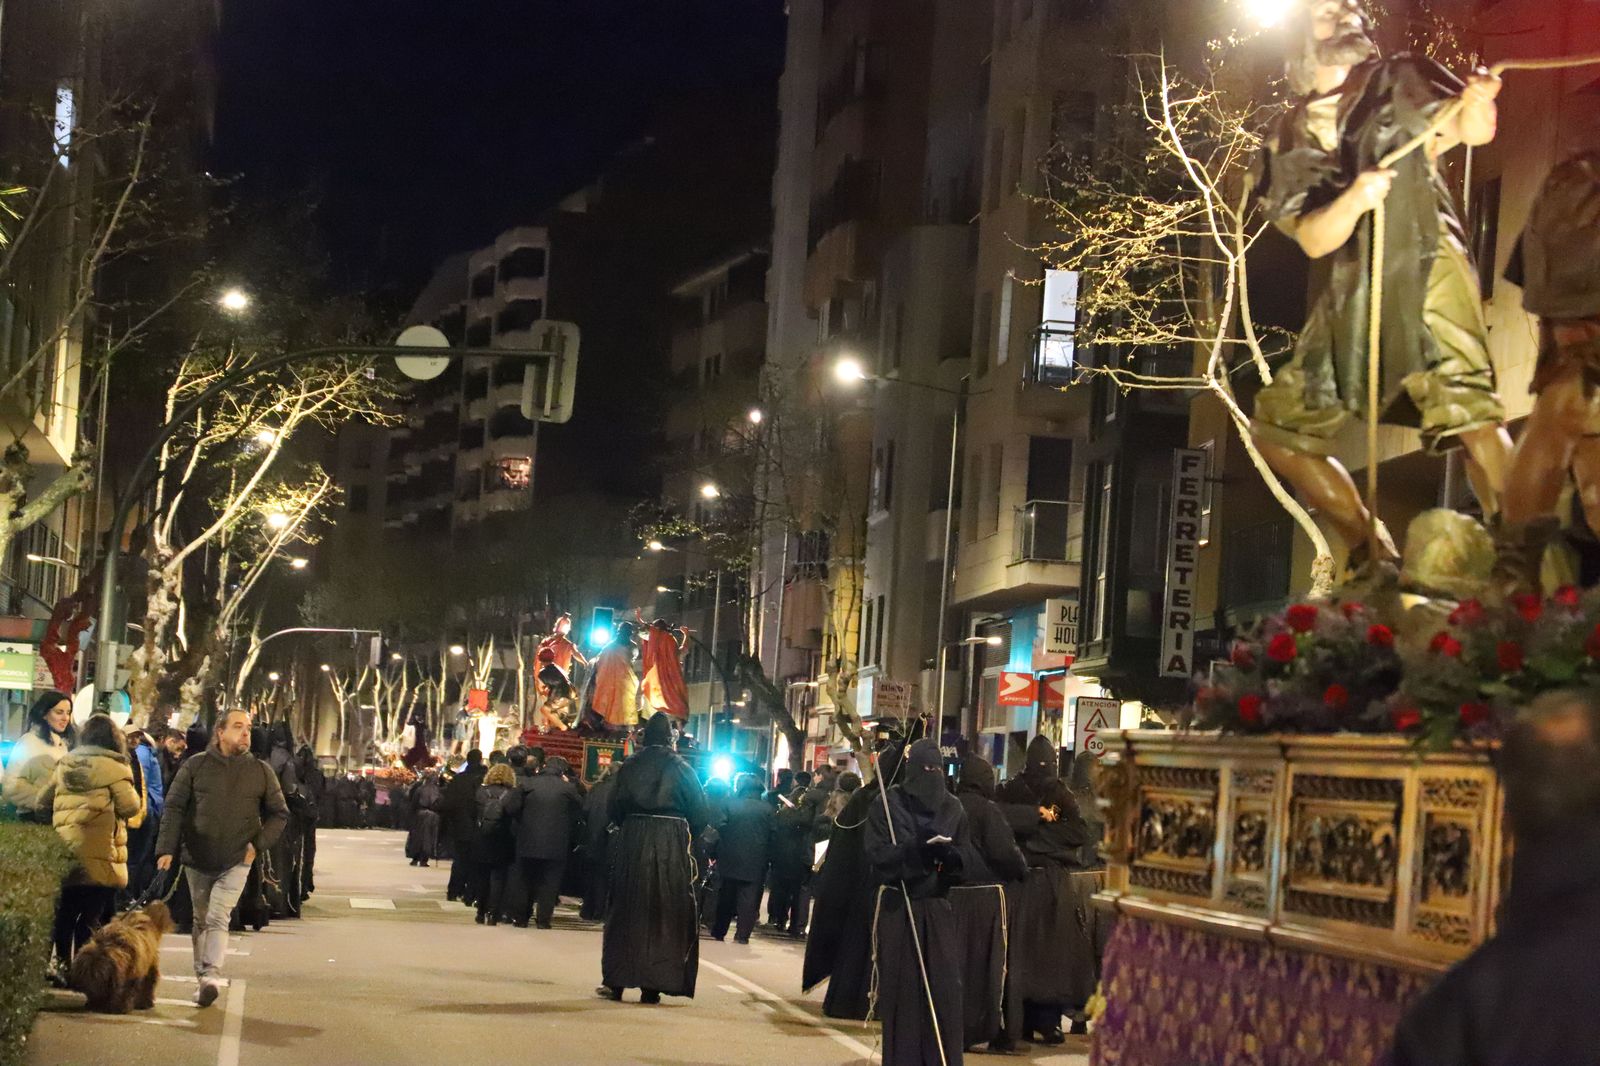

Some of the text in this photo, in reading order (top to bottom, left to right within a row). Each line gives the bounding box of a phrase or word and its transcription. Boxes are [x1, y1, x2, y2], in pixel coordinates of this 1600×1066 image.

[1167, 455, 1201, 673] FERRETERIA
[1061, 605, 1079, 623] PLA
[1053, 627, 1077, 645] HOU
[1090, 741, 1104, 750] 30
